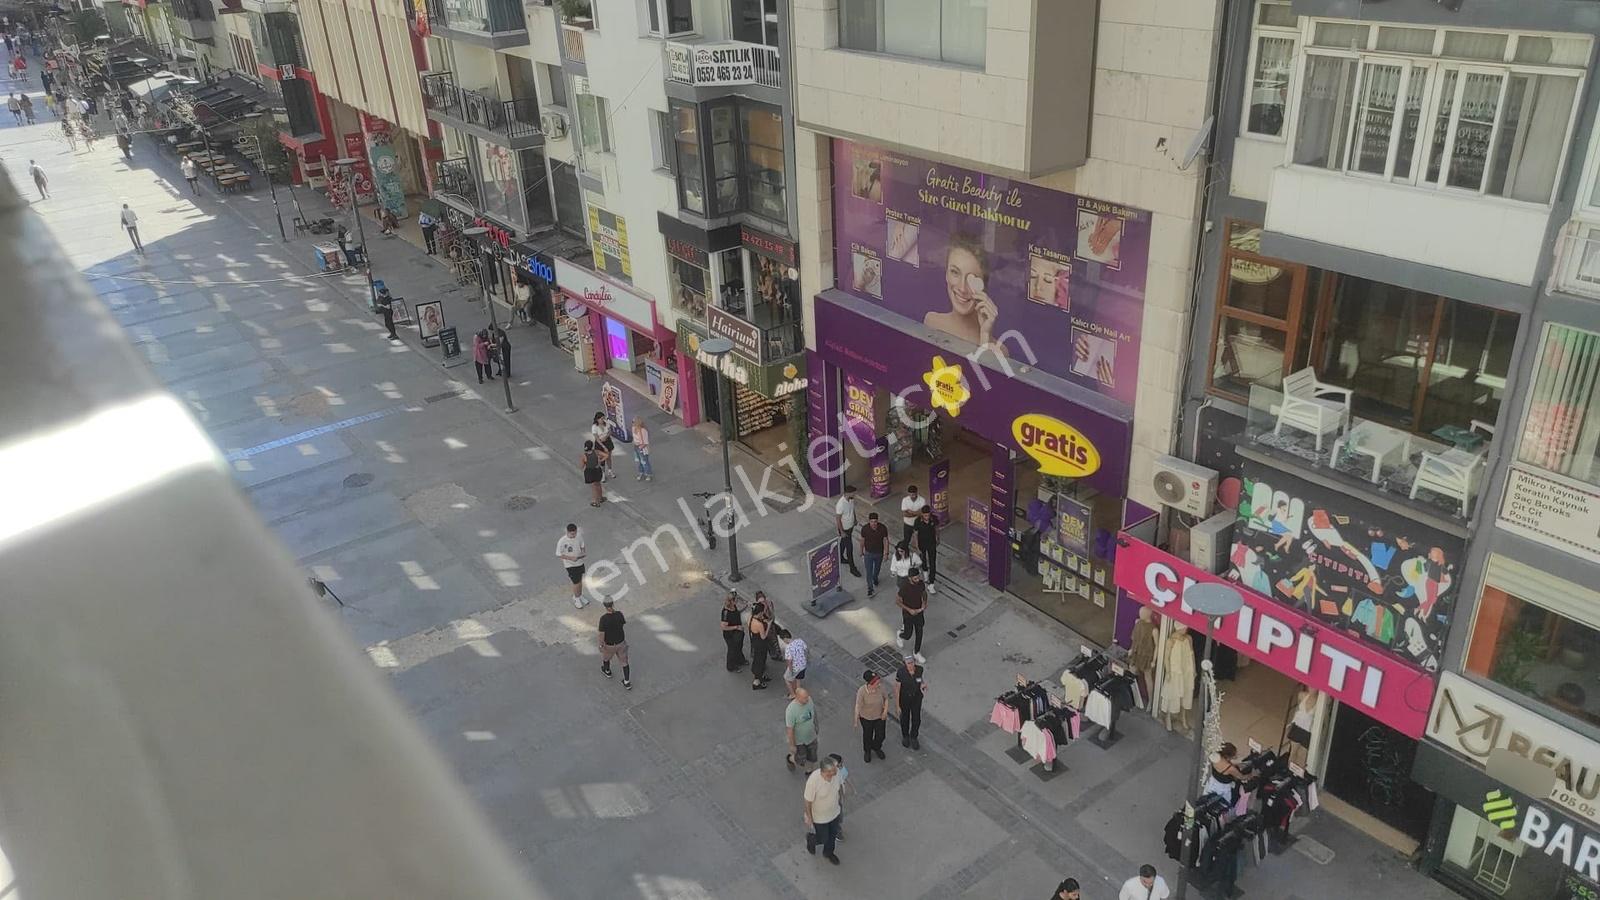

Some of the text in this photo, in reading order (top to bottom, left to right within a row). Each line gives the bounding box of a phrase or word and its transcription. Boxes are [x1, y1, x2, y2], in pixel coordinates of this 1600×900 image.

[713, 48, 750, 63] SATILIK
[697, 67, 715, 82] 0552
[717, 66, 731, 81] 465
[733, 66, 742, 80] 23
[743, 65, 753, 79] 24
[926, 167, 1022, 212] Gratis Beauty ile
[918, 188, 1031, 230] Size Güzel Bakıyoruz
[1092, 201, 1110, 213] Ayak
[712, 315, 756, 349] Hairium
[1090, 322, 1102, 334] Oje
[1103, 325, 1117, 337] Nail
[1119, 330, 1130, 342] Art
[774, 378, 808, 397] Aloha
[936, 379, 954, 392] gratis
[849, 385, 873, 408] DEV
[1021, 422, 1087, 465] gratis
[1516, 484, 1589, 514] Keratin Kaynak
[1518, 475, 1586, 503] Mikro Kaynak
[1535, 500, 1570, 517] Botoks
[1062, 513, 1084, 532] DEV
